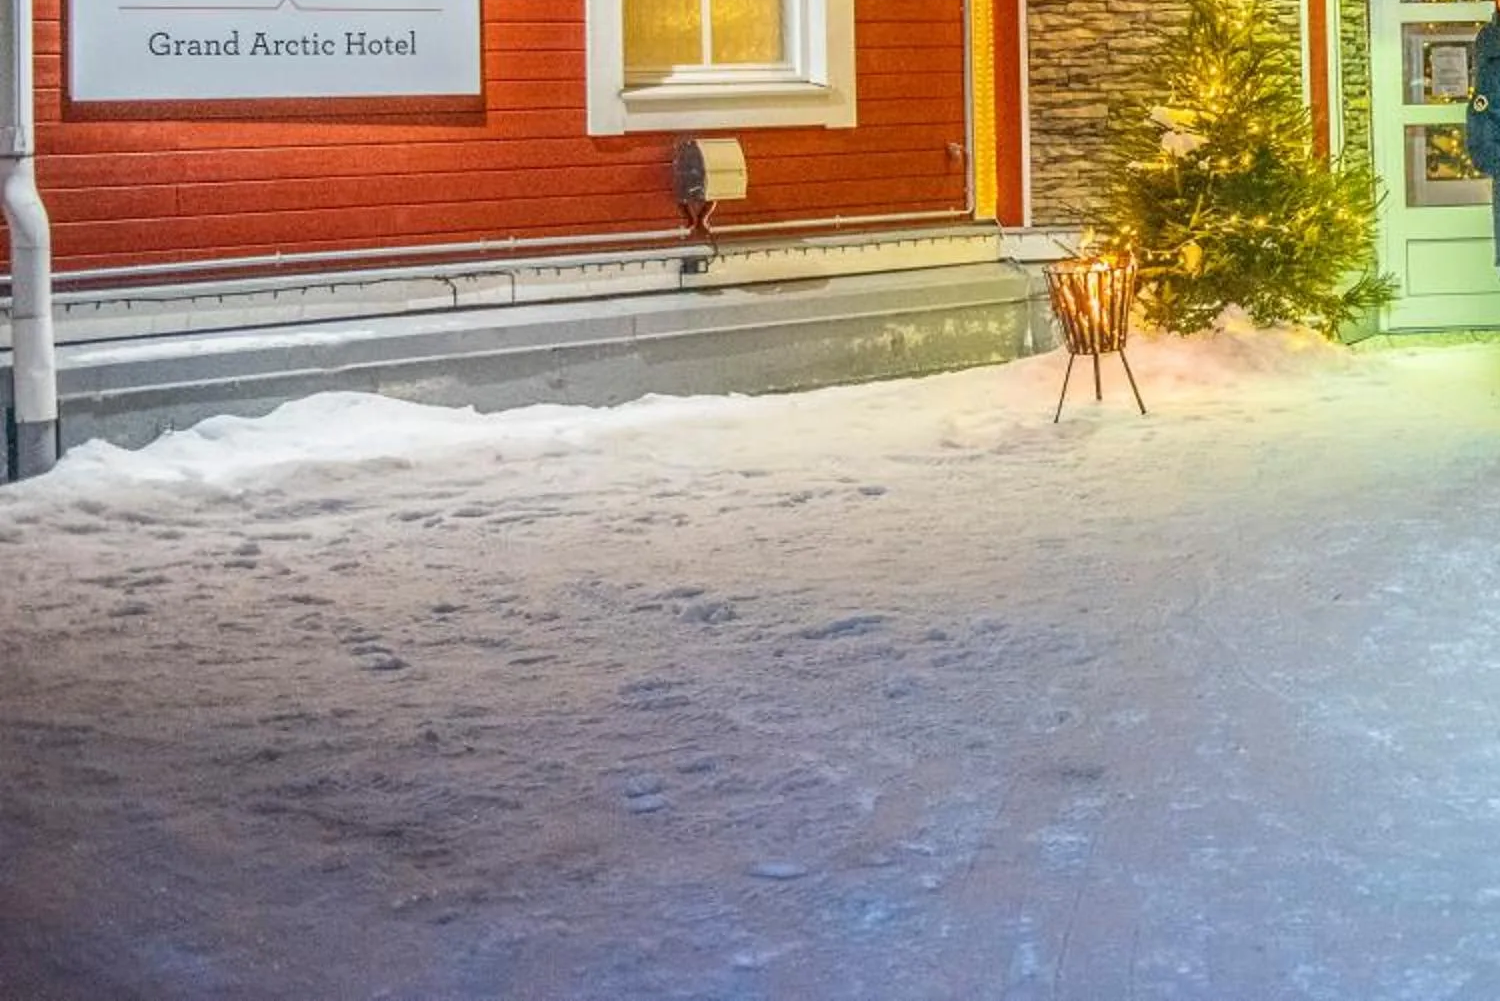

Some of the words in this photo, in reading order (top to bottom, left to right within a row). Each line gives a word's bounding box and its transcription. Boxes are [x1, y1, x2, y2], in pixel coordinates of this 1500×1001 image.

[148, 30, 240, 56] Grand
[250, 30, 336, 57] Arctic
[345, 30, 417, 56] Hotel
